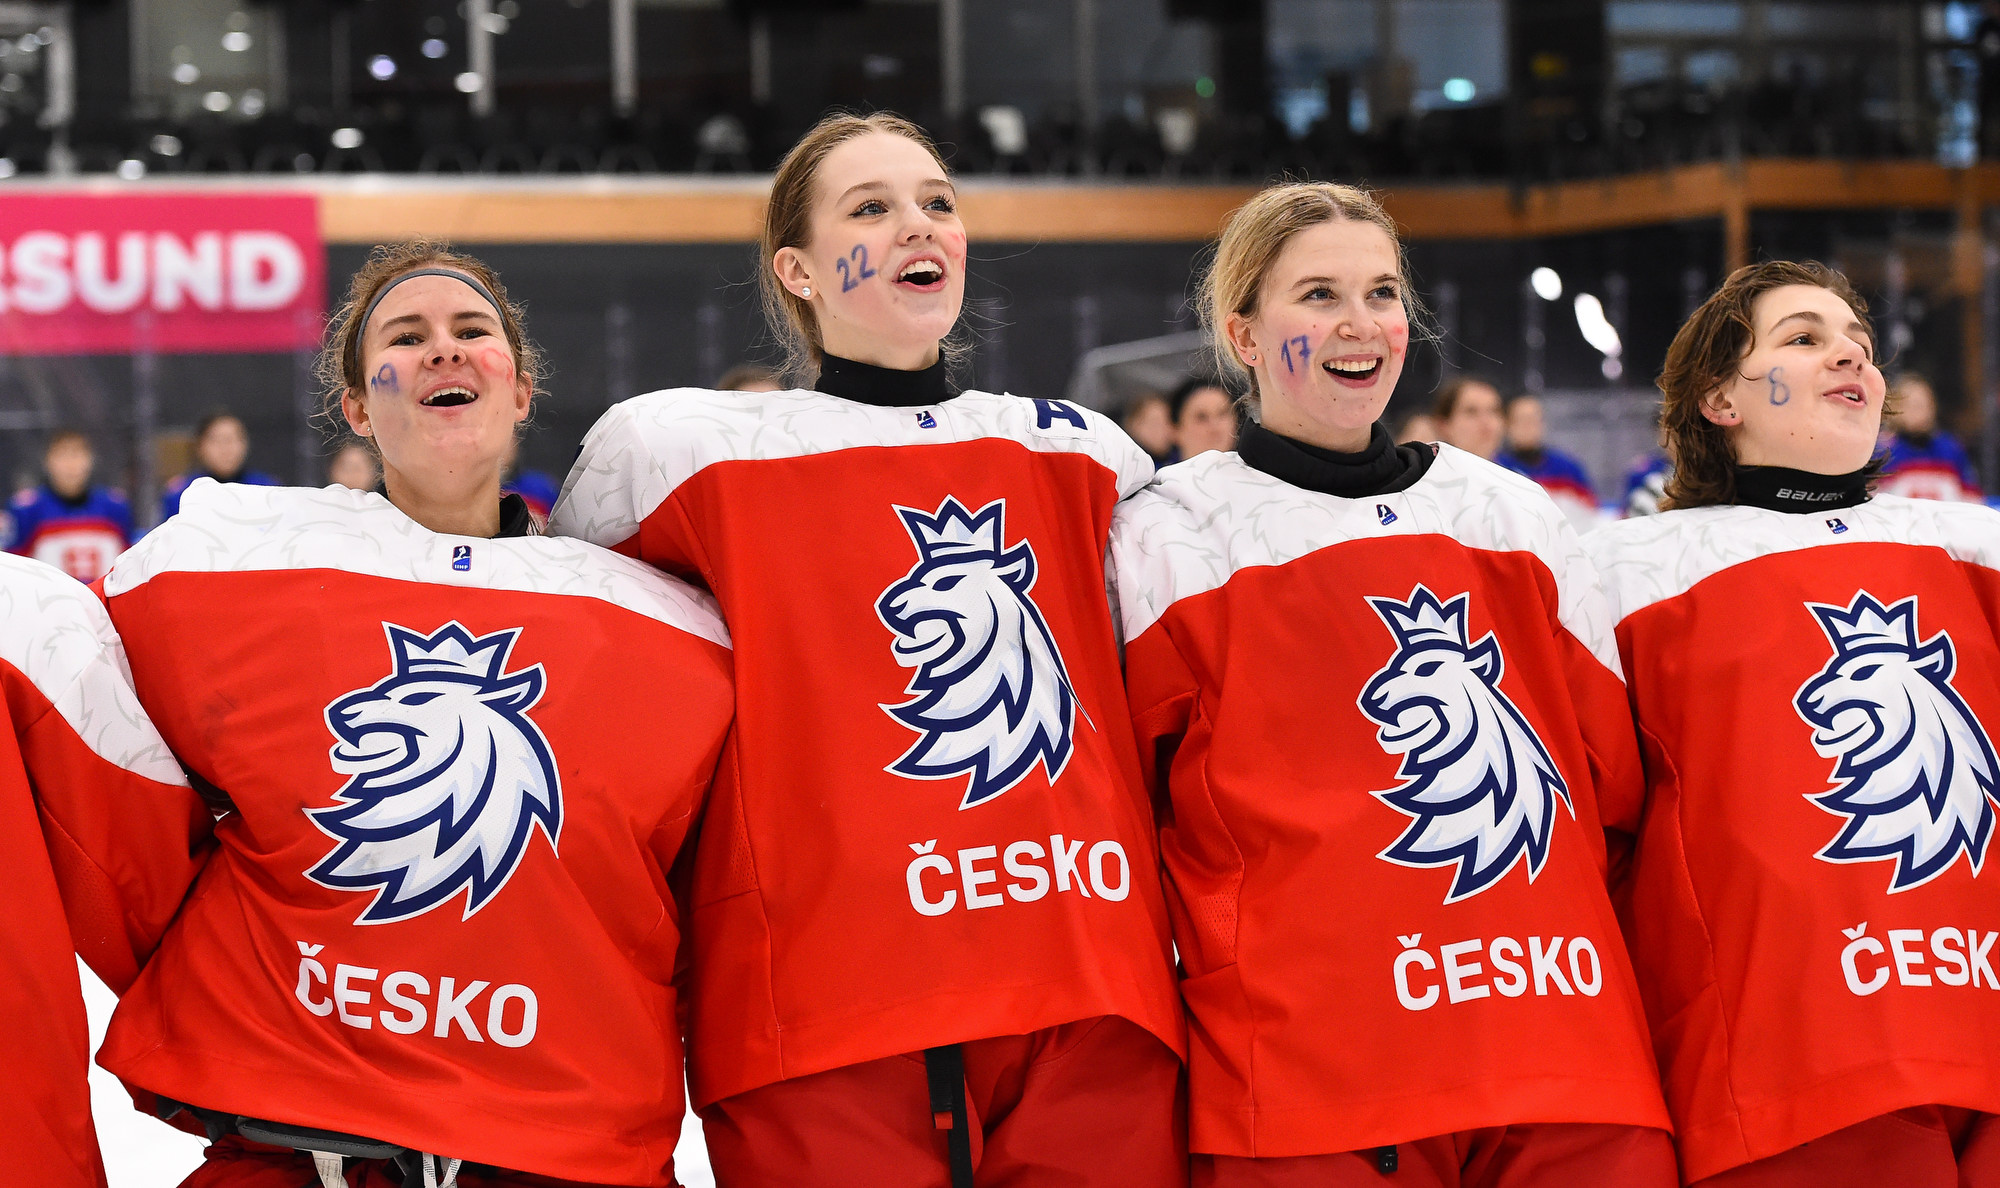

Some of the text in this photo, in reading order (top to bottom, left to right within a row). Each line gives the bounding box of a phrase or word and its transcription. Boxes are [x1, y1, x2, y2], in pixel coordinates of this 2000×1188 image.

[836, 243, 876, 293] 22
[1280, 334, 1311, 376] 17
[1768, 366, 1791, 406] 8
[1032, 398, 1088, 430] A
[905, 833, 1131, 917] ČESKO
[294, 940, 539, 1048] ČESKO
[1393, 932, 1603, 1011] ČESKO
